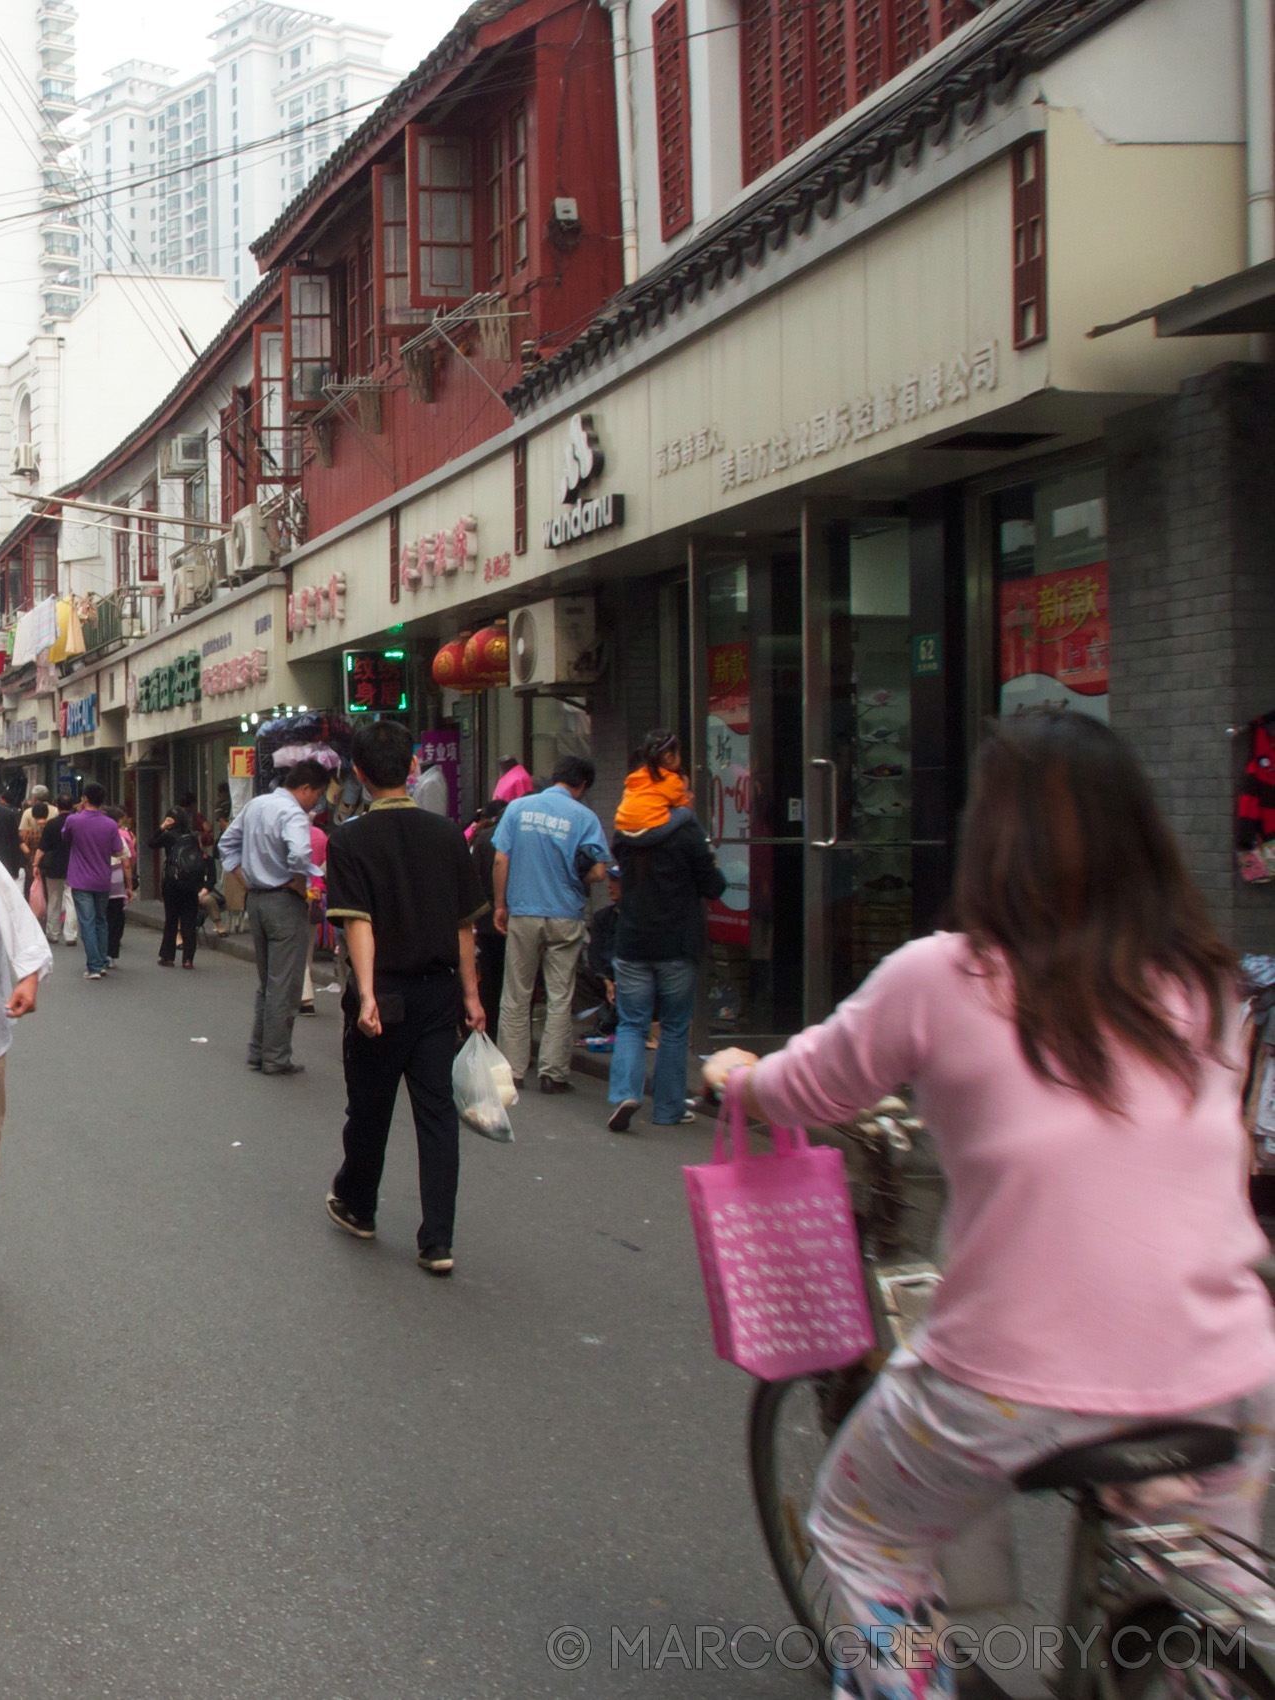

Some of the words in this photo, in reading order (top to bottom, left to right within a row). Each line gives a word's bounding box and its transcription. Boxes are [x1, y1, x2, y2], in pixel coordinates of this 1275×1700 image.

[543, 495, 616, 549] wandanu
[1037, 576, 1101, 628] 新款
[918, 638, 935, 661] 62
[231, 747, 255, 775] 厂家
